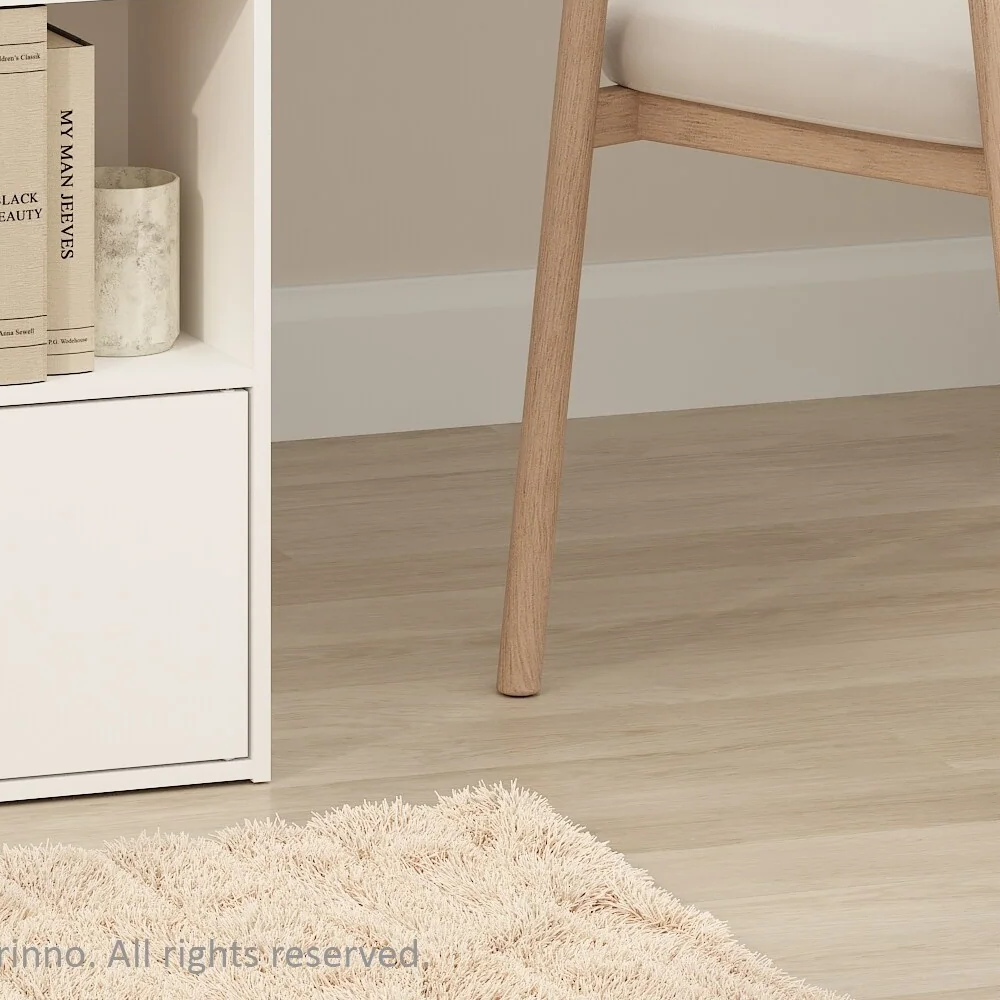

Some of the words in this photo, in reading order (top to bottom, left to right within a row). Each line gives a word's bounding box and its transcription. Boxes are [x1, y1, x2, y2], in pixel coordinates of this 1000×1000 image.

[60, 109, 74, 138] MY
[60, 144, 74, 188] MAN
[60, 194, 74, 260] JEEVES
[15, 328, 35, 336] Sewell
